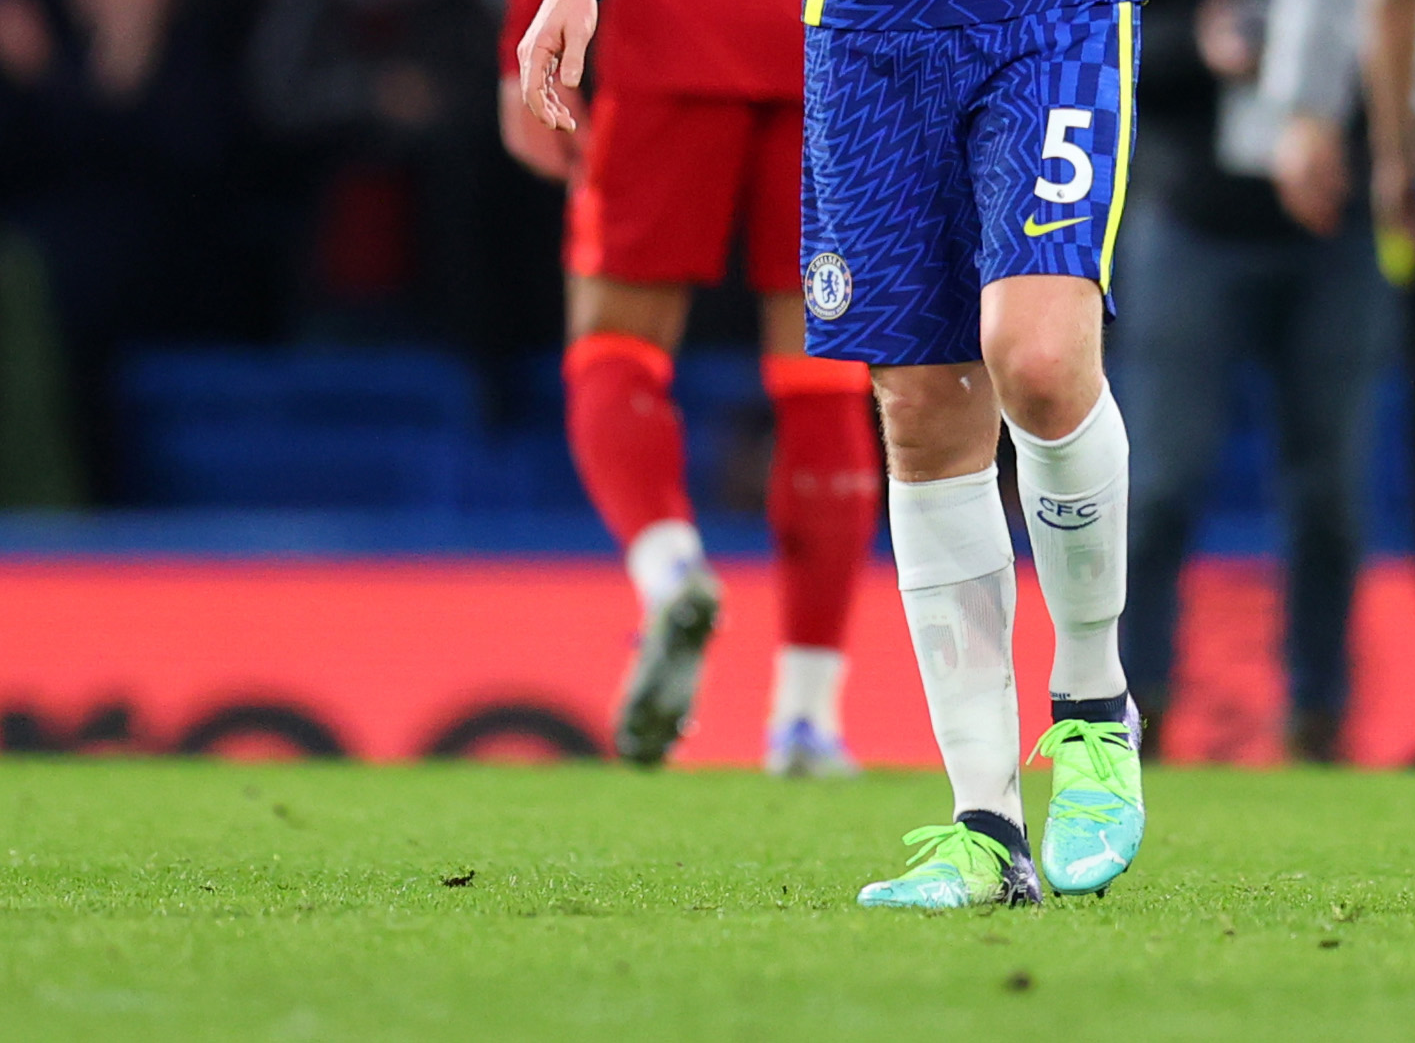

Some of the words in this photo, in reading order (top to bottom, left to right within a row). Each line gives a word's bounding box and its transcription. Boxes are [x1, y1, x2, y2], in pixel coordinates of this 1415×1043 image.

[1034, 108, 1094, 204] 5
[811, 255, 842, 273] CHELSEA
[1039, 498, 1098, 517] CFC
